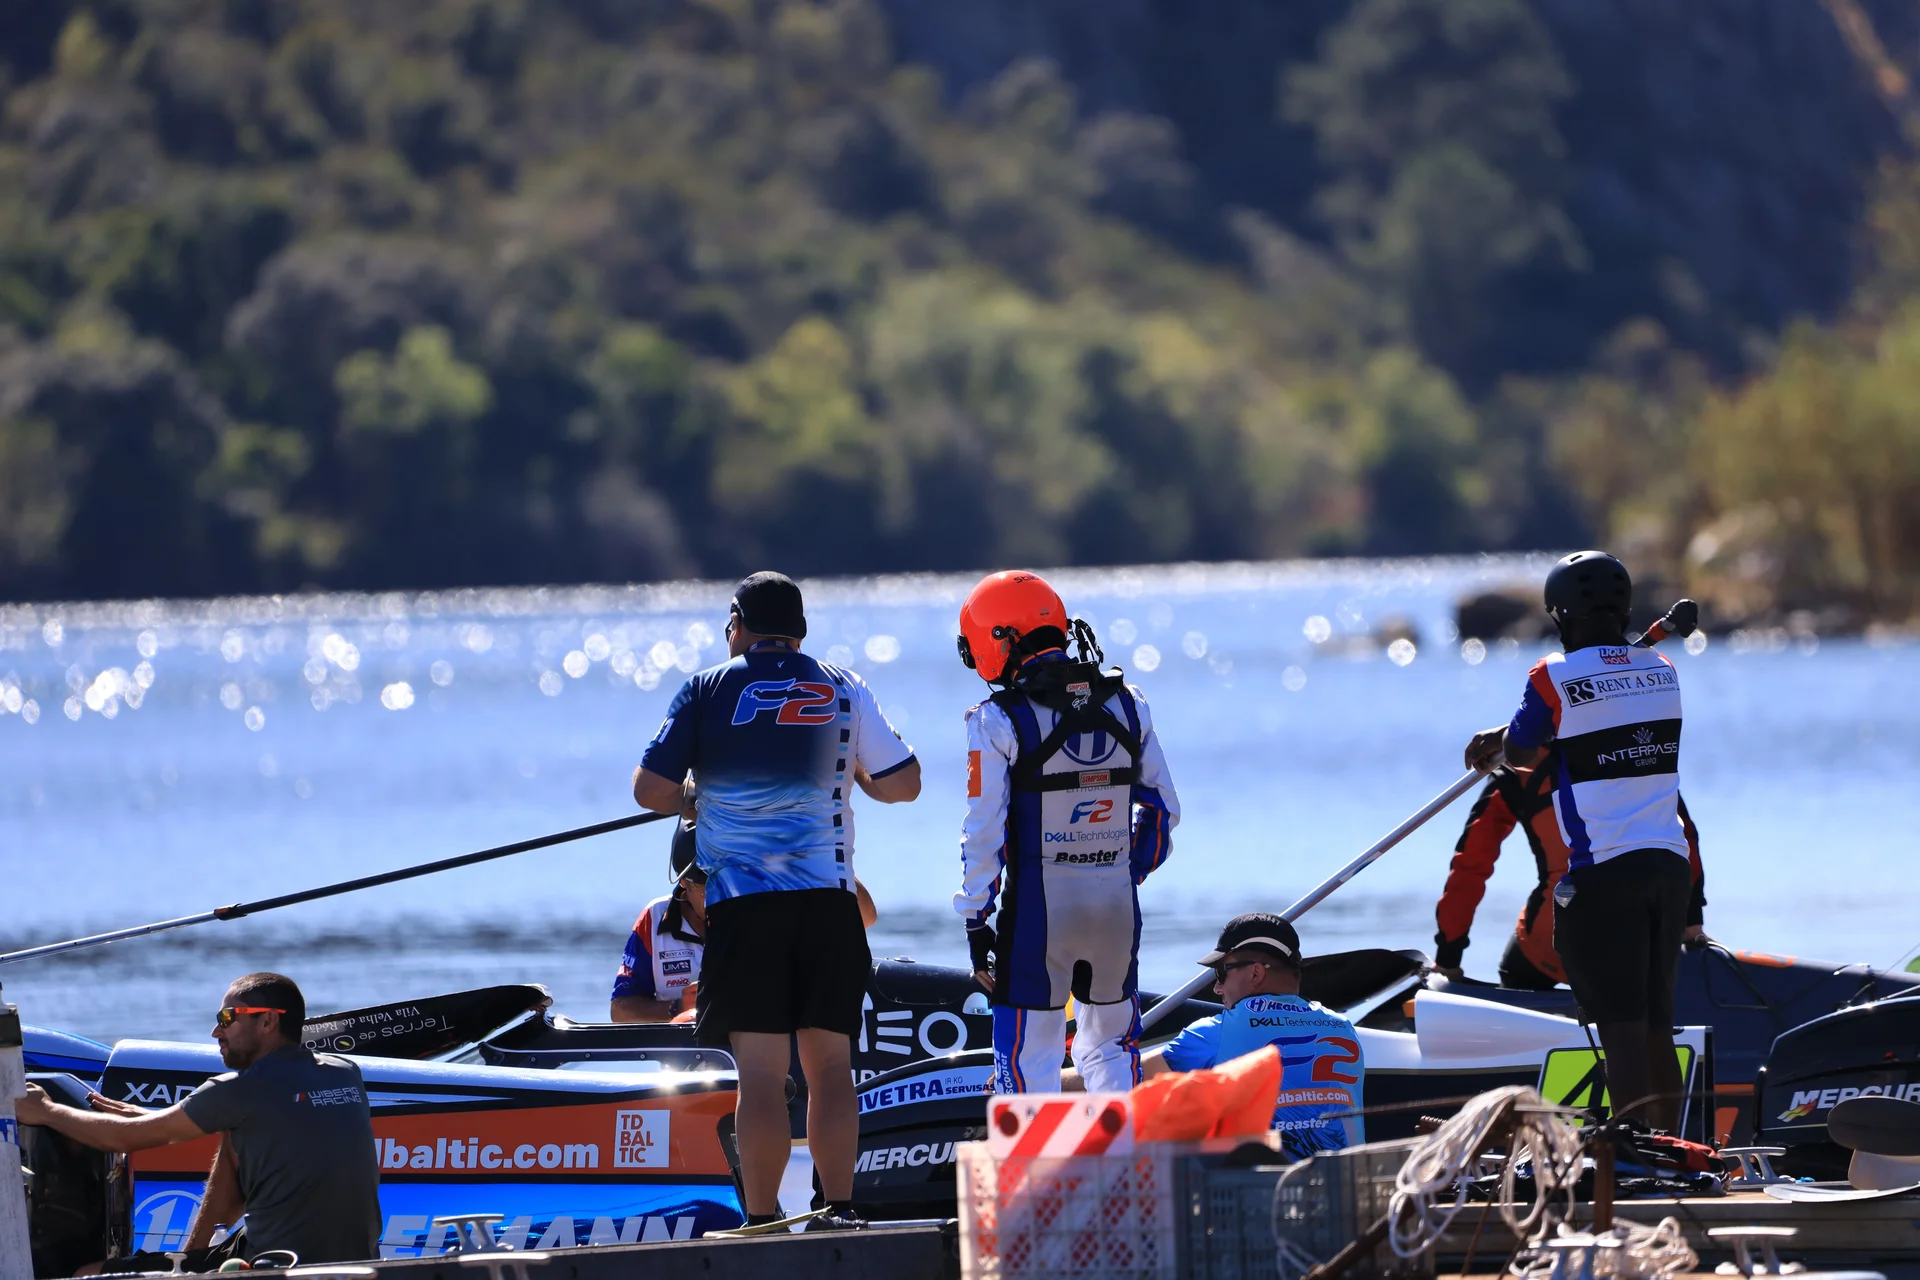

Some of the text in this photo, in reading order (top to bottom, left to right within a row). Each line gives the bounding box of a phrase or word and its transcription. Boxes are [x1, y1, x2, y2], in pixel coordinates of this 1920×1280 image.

[1600, 647, 1627, 656] LIQUI
[1603, 656, 1629, 665] MOLY
[1566, 672, 1676, 705] RS RENT A STAR
[731, 677, 836, 725] F2
[1605, 692, 1629, 701] premium
[1596, 742, 1678, 766] INTERPASS
[1635, 757, 1657, 767] GRUPO
[1081, 774, 1108, 784] SIMPSON
[1069, 800, 1114, 824] F2
[1054, 849, 1119, 864] Beaster
[302, 1006, 421, 1033] Vila Velha de Ródão
[1249, 1016, 1346, 1029] DELL Technologies
[305, 1015, 454, 1052] Terras de Oiro
[954, 1076, 963, 1084] KO
[308, 1087, 360, 1098] WIBERG
[1277, 1090, 1350, 1105] dbaltic.com
[312, 1094, 363, 1107] RACING
[621, 1114, 643, 1130] TD
[1275, 1118, 1329, 1132] Beaster
[620, 1130, 654, 1147] BAL
[375, 1137, 599, 1169] baltic.com
[619, 1147, 646, 1164] TIC
